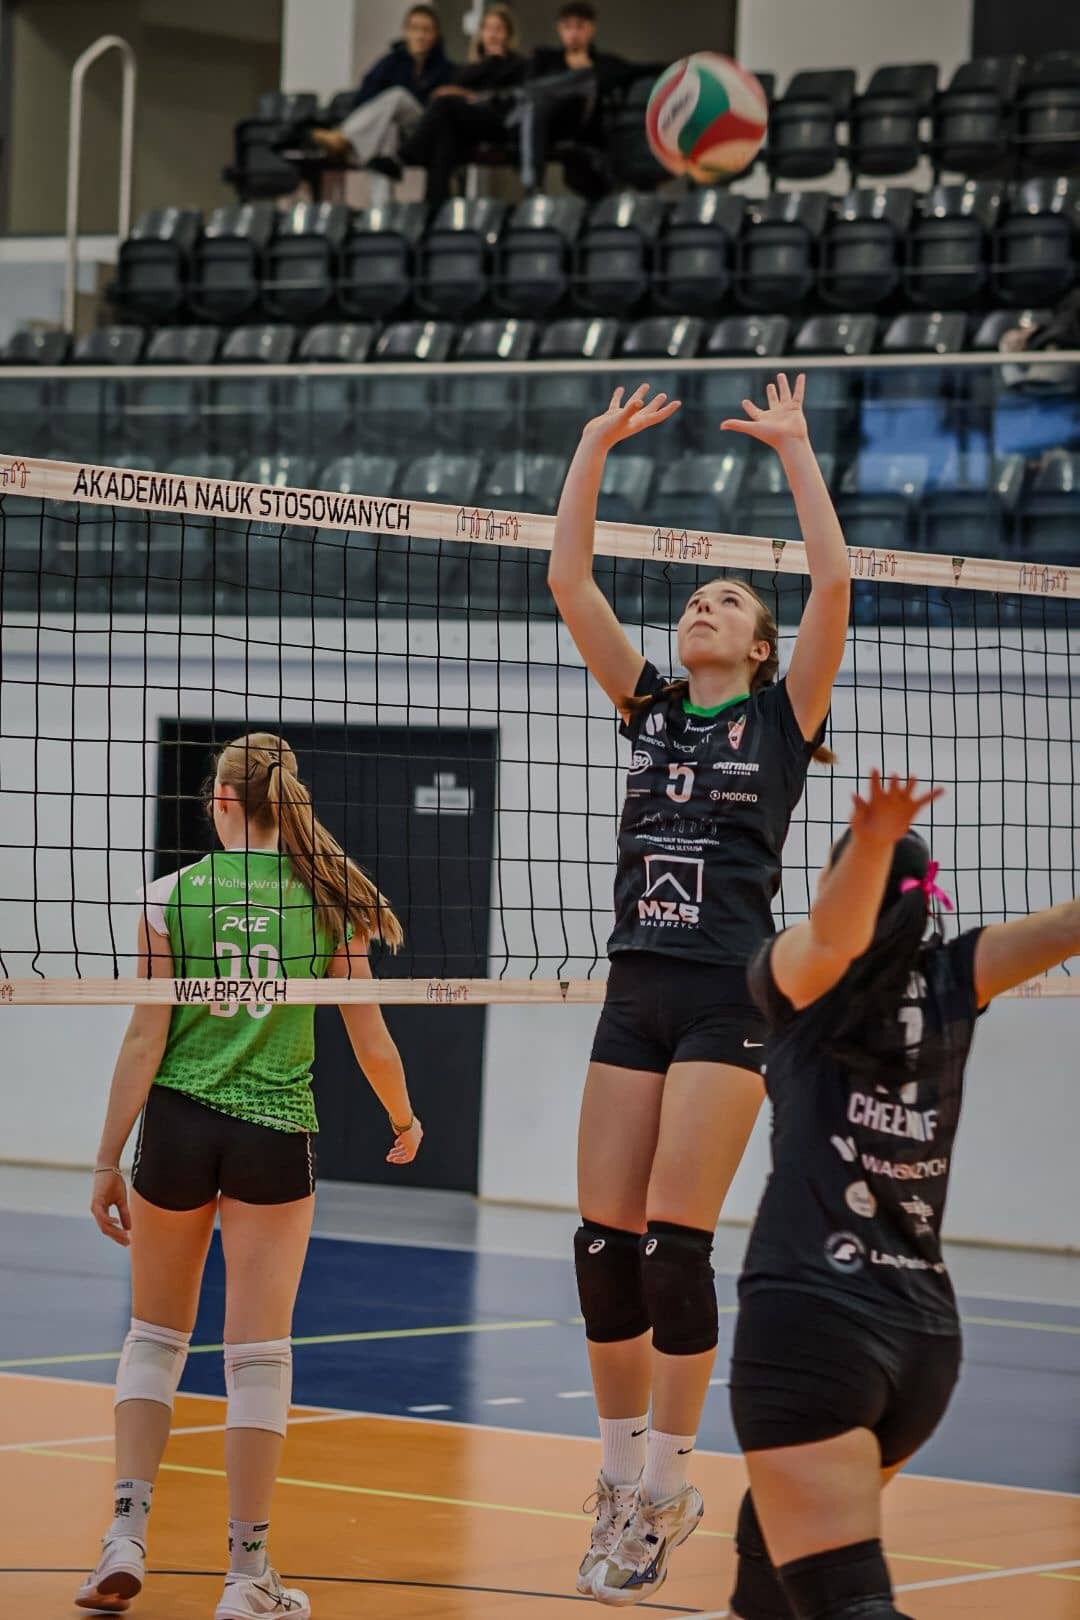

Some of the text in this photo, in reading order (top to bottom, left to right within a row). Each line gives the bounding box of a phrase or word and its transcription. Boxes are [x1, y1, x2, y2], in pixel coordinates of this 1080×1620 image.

[73, 468, 411, 531] AKADEMIA NAUK STOSOWANYCH
[666, 761, 698, 803] 5
[721, 791, 758, 803] MODEKO
[638, 899, 700, 924] MZB
[222, 916, 270, 932] PGE
[174, 980, 287, 1002] WAŁBRZYCH
